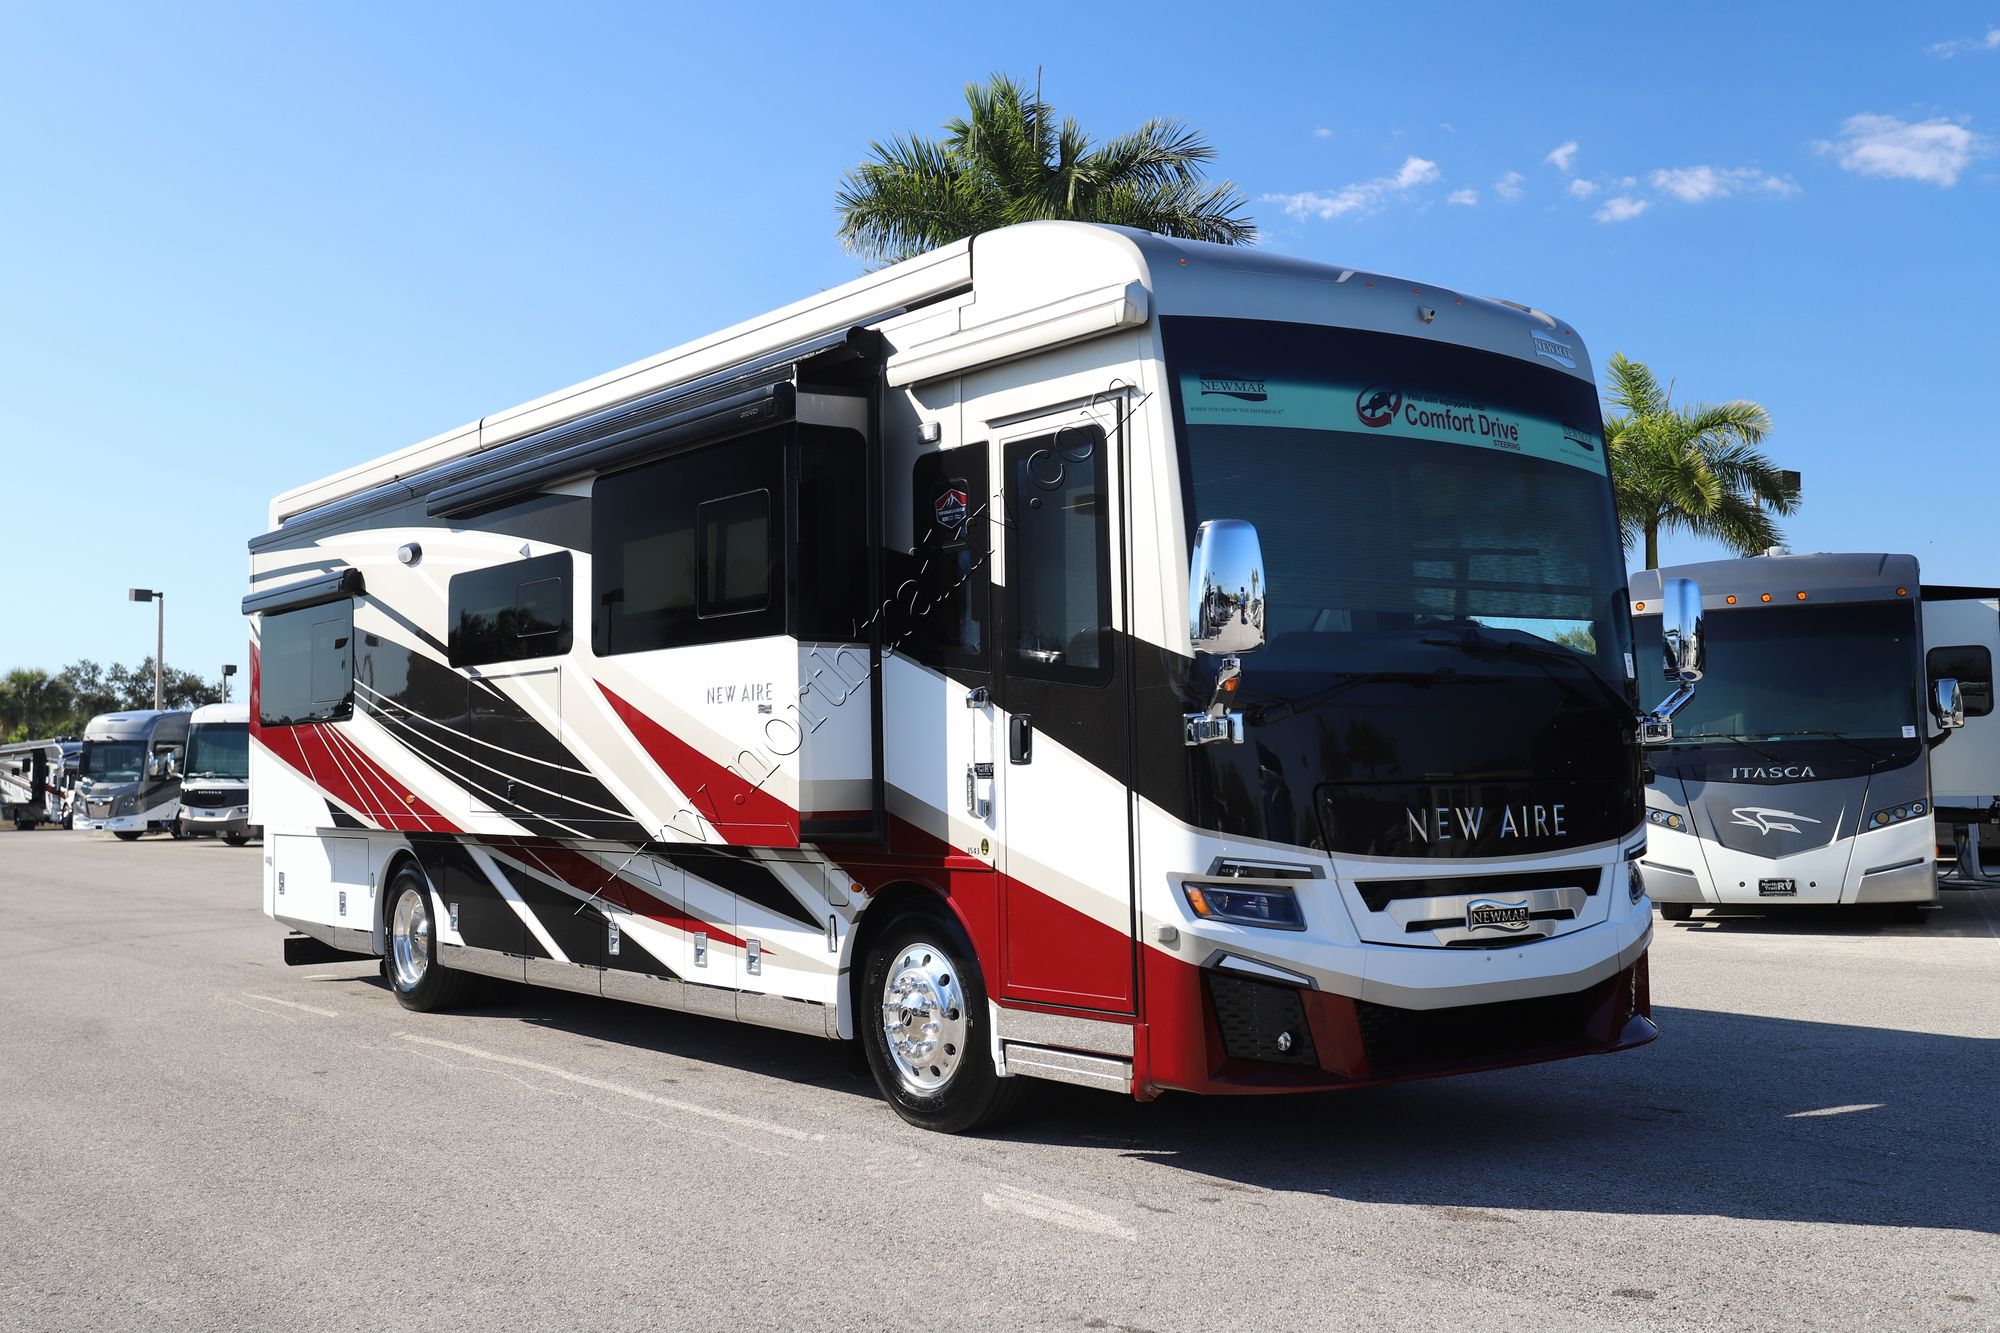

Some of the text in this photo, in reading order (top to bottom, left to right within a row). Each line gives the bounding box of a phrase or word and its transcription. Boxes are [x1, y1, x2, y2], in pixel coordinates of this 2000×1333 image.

[1534, 339, 1573, 360] NEWMAR
[1200, 380, 1266, 393] NEWMAR
[1405, 403, 1519, 441] Comfort Drive
[1493, 440, 1521, 451] STEERING
[707, 682, 772, 704] NEW AIRE
[1732, 766, 1816, 779] ITASCA
[1406, 804, 1567, 844] NEW AIRE
[967, 847, 980, 855] 3543
[1777, 882, 1793, 891] RV
[1473, 909, 1529, 924] NEWMAR
